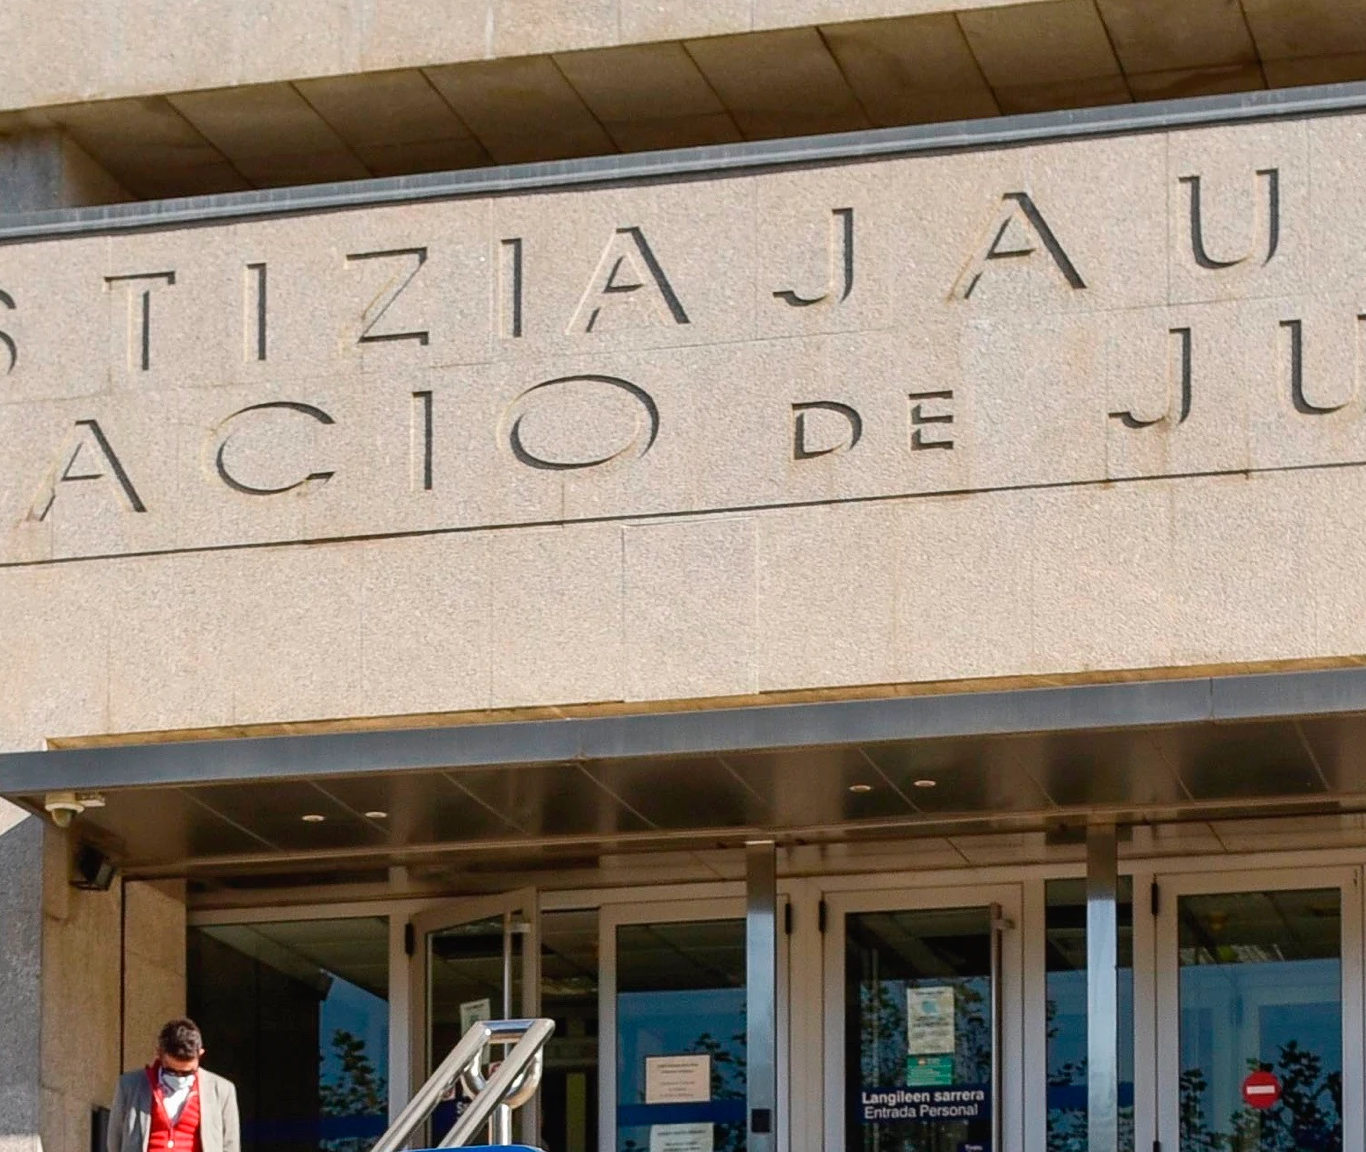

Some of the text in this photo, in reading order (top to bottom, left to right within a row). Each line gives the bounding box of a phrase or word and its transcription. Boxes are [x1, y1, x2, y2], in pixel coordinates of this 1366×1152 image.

[791, 390, 955, 461] DE
[861, 1089, 985, 1107] Langileen sarrera
[864, 1103, 979, 1120] Entrada Personal
